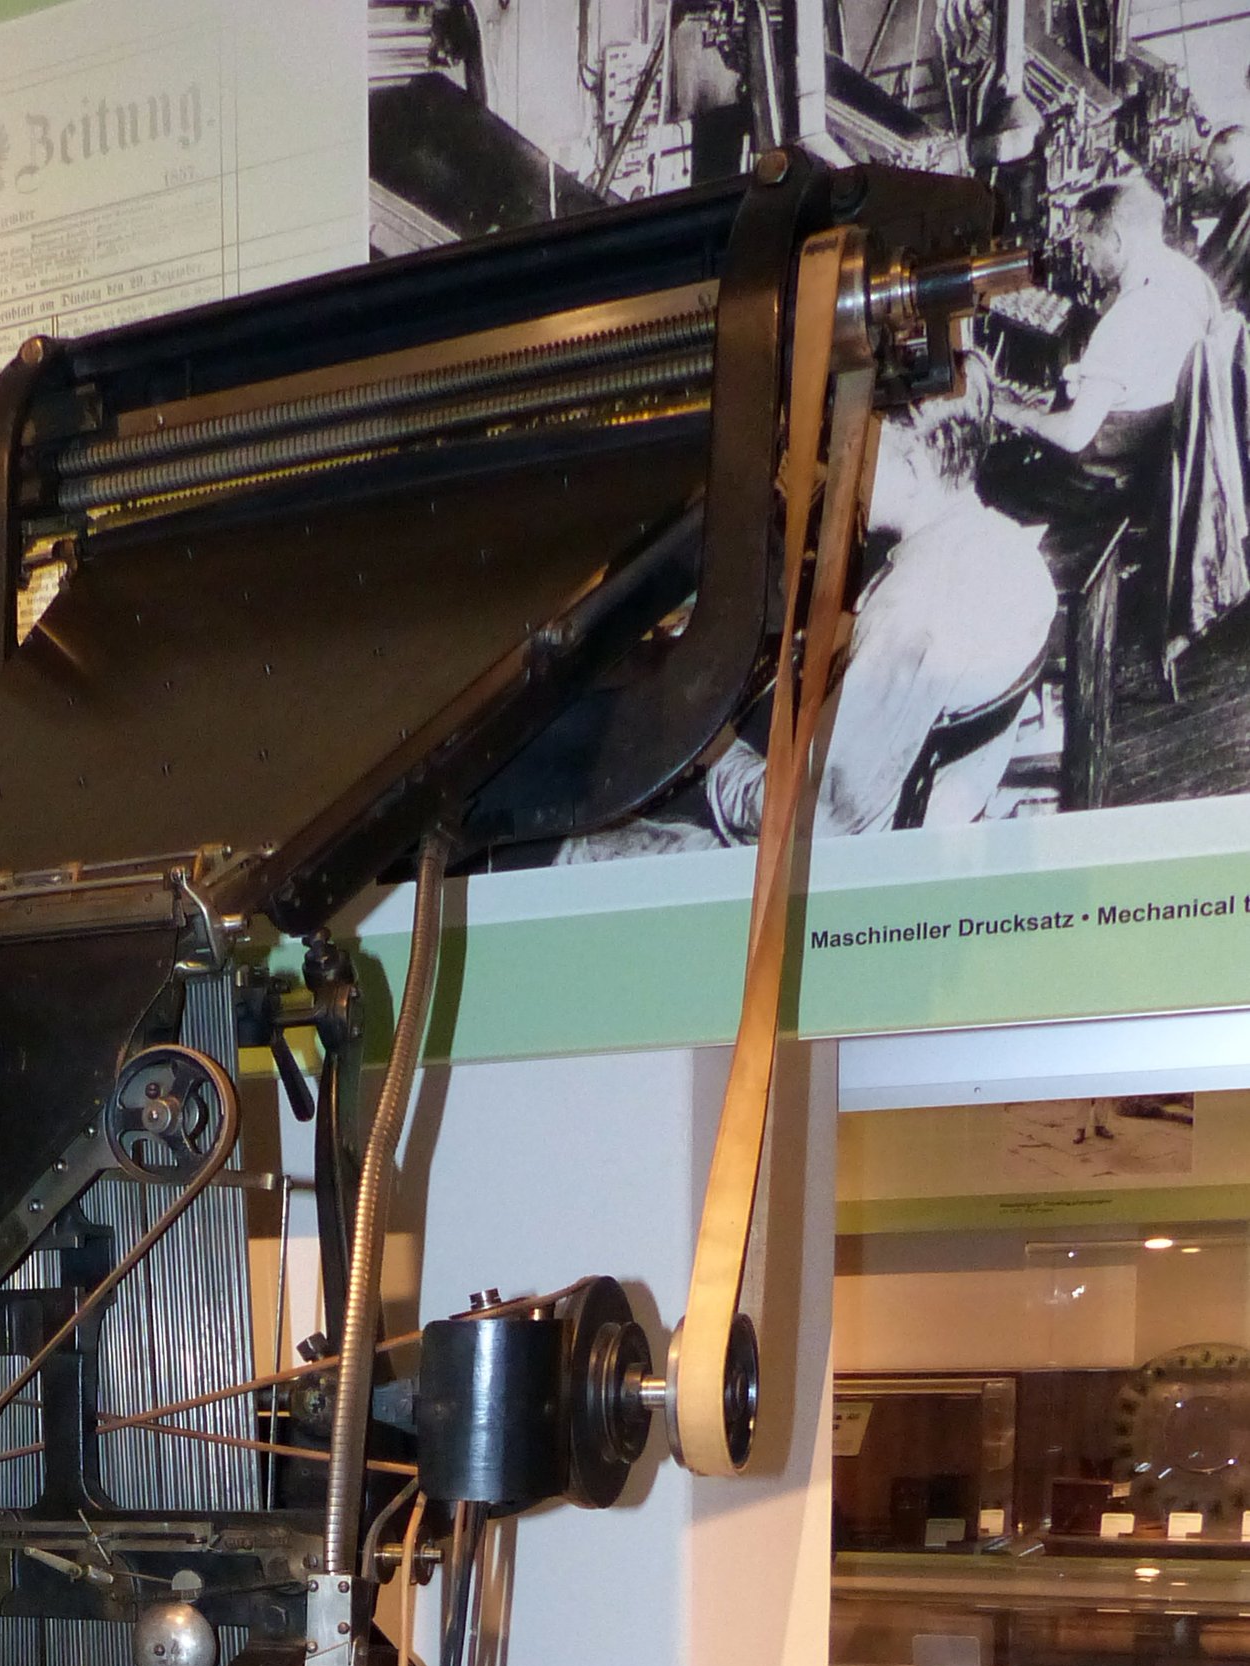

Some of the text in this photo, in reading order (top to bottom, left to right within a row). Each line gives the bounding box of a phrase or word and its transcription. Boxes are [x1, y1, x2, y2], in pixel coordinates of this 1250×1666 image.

[811, 921, 951, 949] Maschineller
[958, 911, 1075, 938] Drucksatz
[1097, 895, 1235, 926] Mechanical
